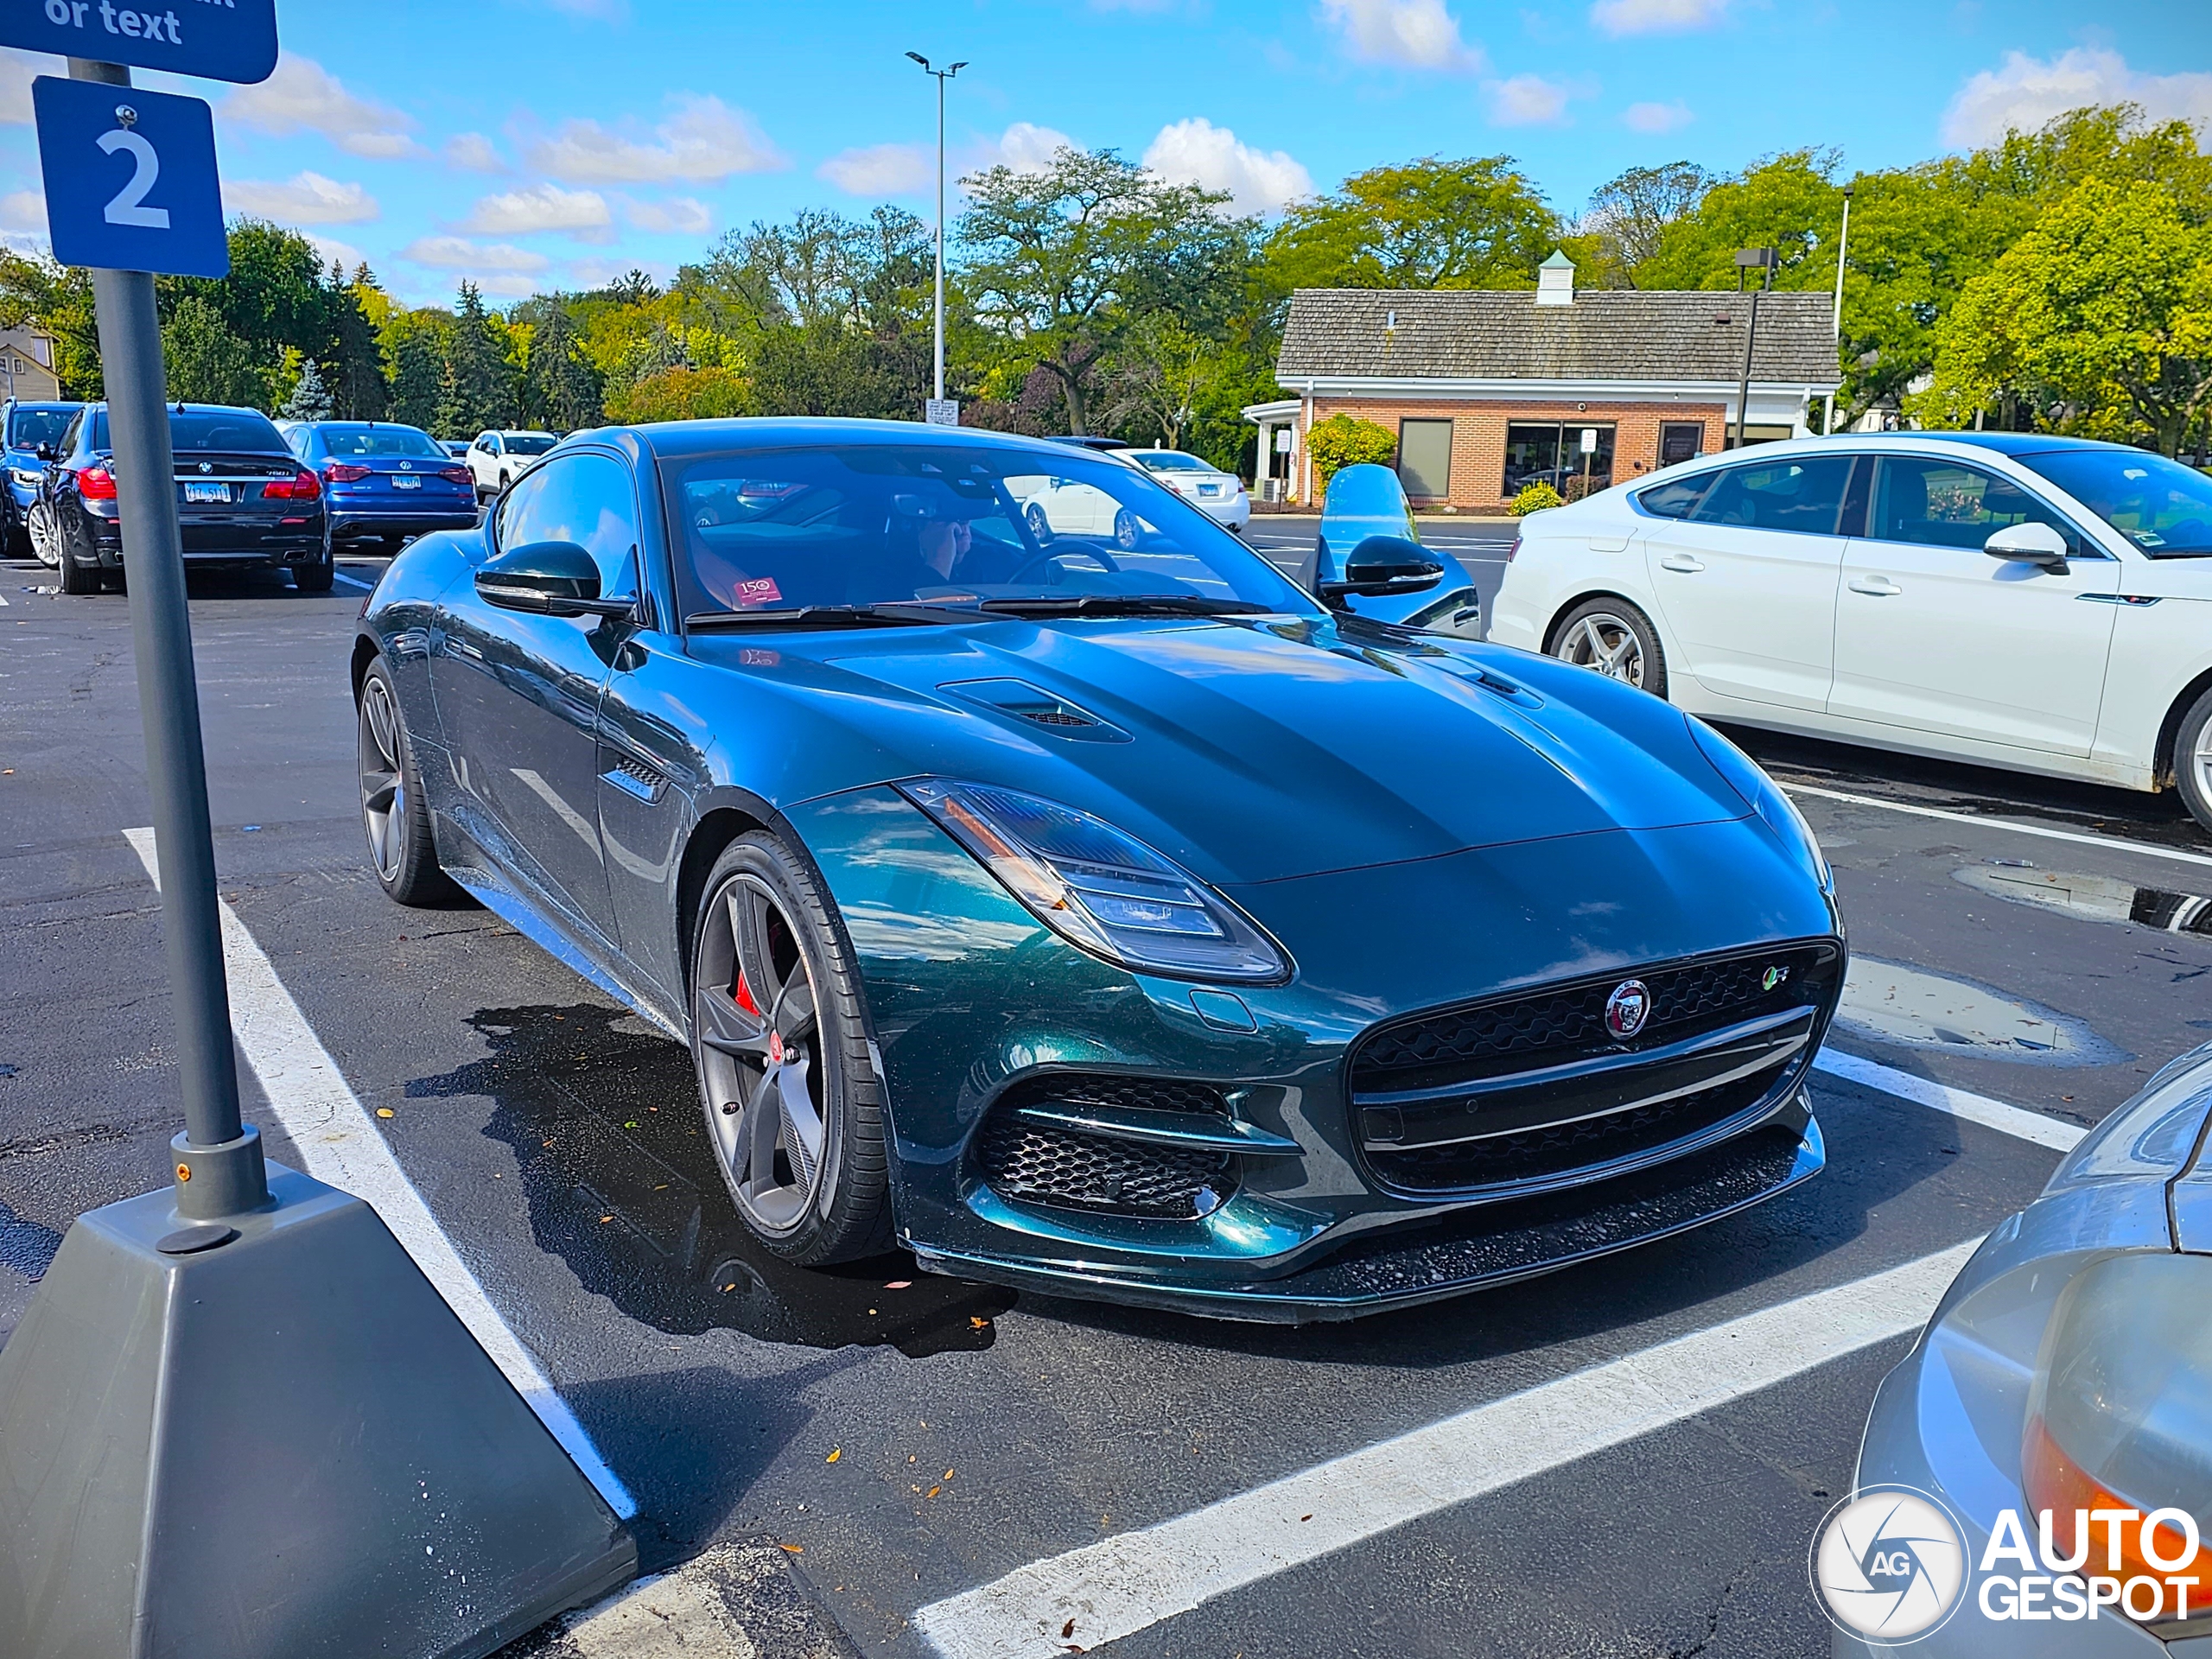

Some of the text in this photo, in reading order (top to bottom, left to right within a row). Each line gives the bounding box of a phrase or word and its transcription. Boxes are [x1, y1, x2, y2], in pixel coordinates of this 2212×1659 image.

[45, 0, 182, 45] or text
[95, 128, 171, 229] 2
[208, 487, 229, 499] 5111
[740, 580, 770, 594] 150
[616, 774, 645, 792] JAGUAR
